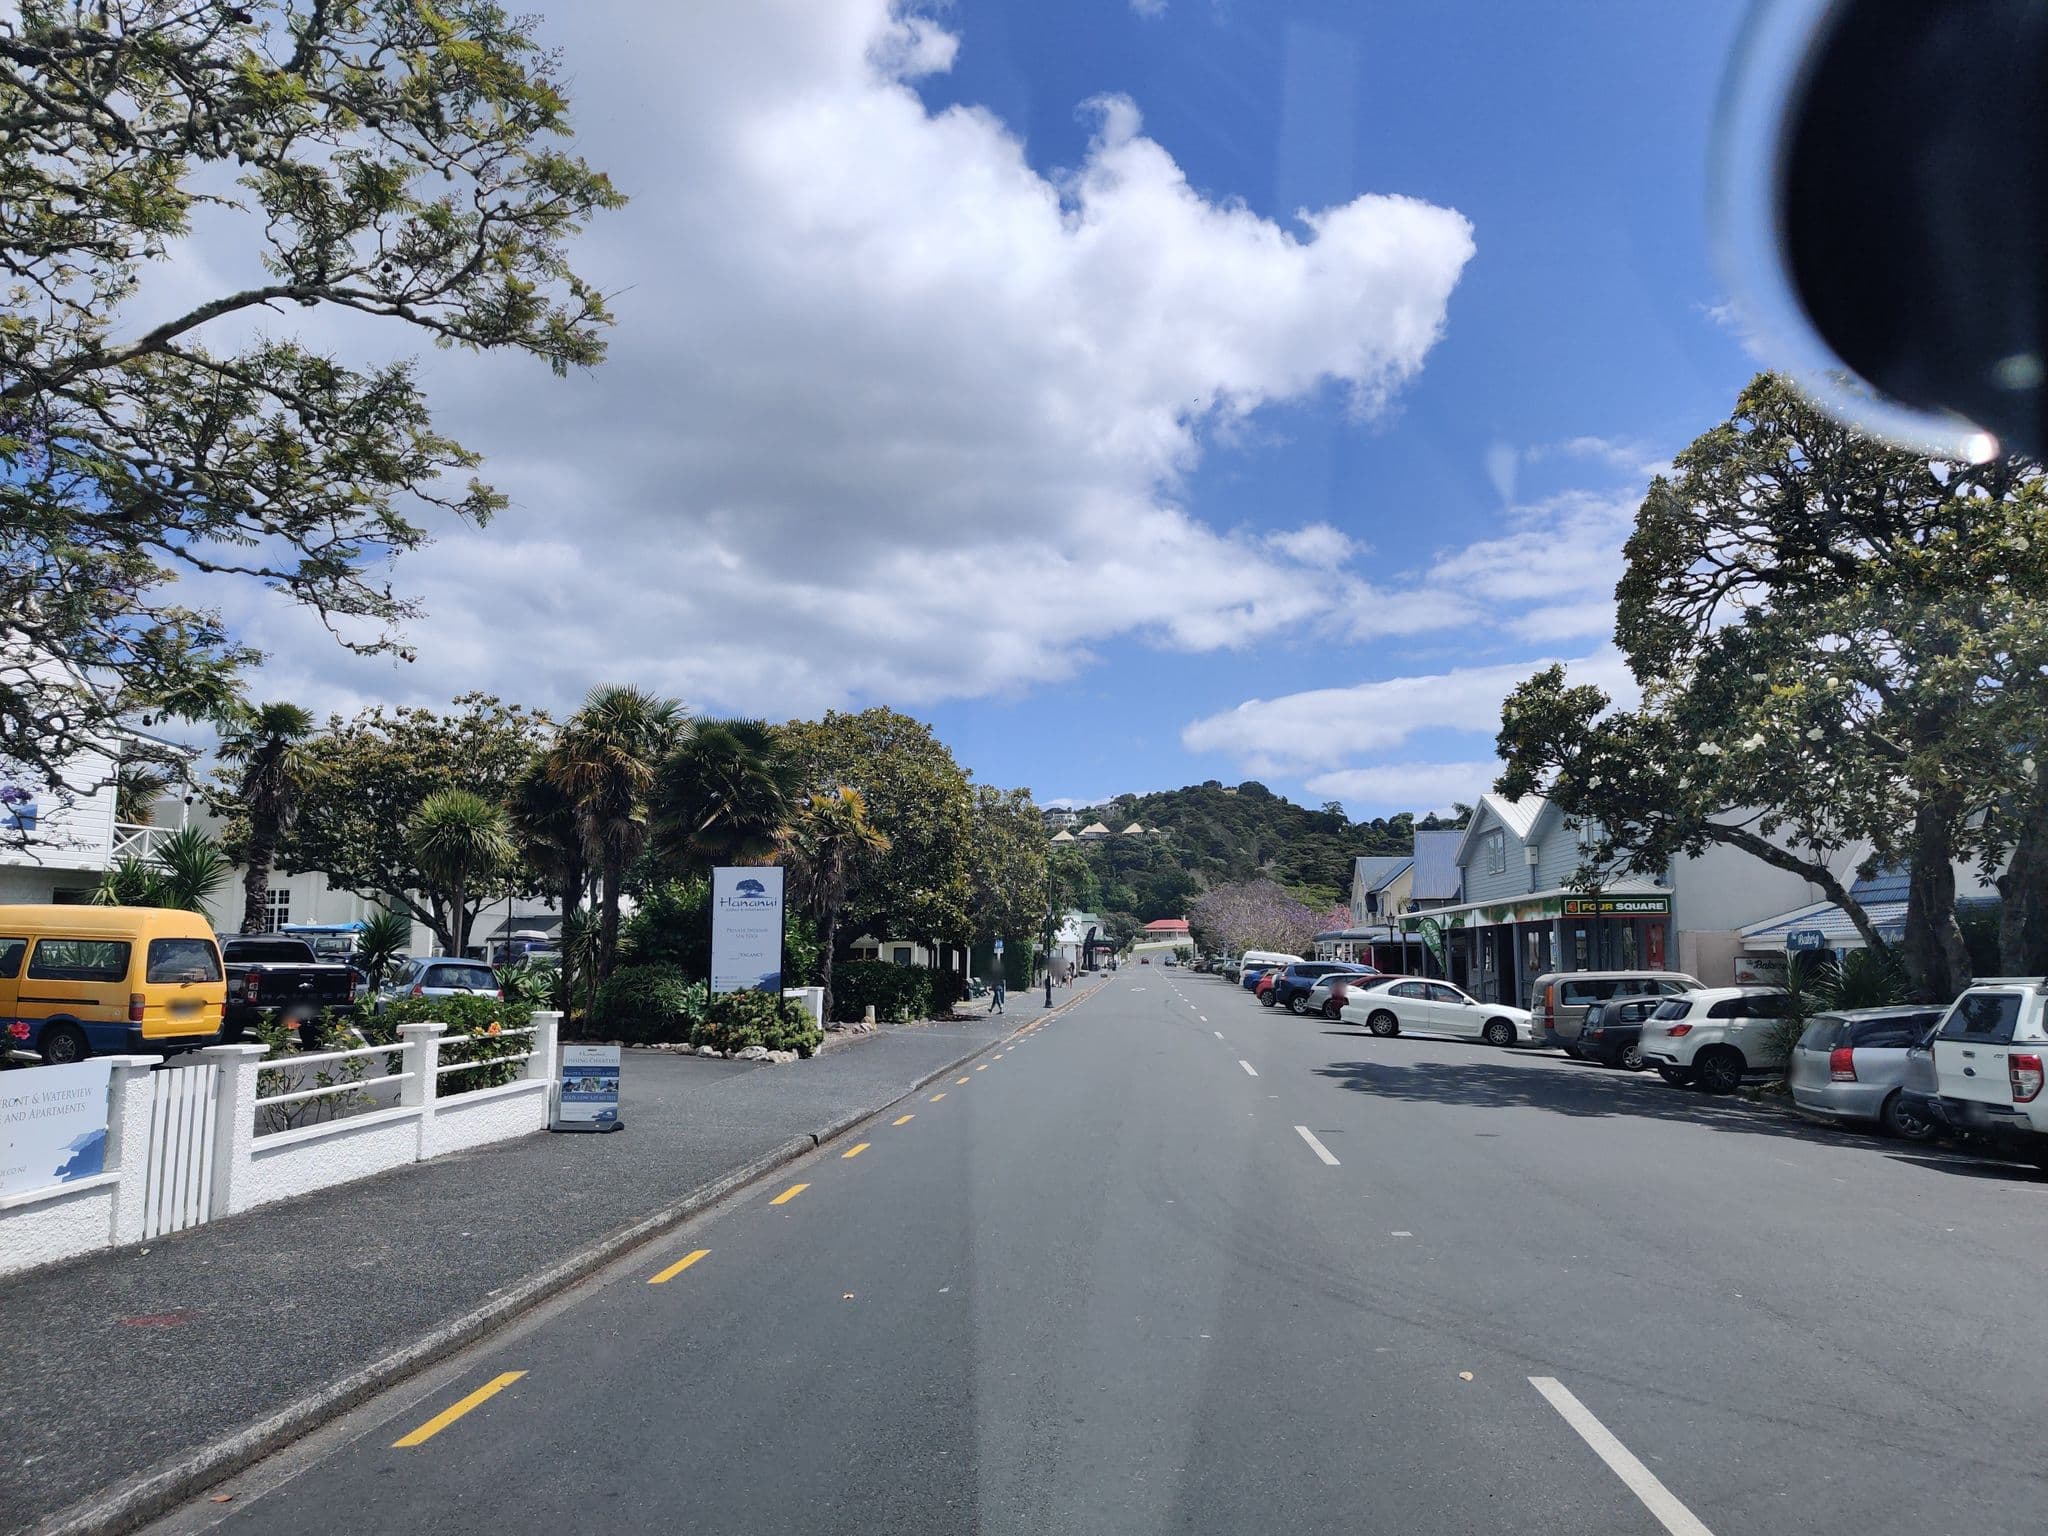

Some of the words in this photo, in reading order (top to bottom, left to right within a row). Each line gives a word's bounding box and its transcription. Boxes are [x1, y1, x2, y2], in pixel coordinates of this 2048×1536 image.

[719, 897, 777, 907] Hananui
[1616, 902, 1664, 911] SQUARE
[32, 1092, 40, 1104] &
[42, 1088, 93, 1103] WATERVIEW
[4, 1111, 26, 1123] AND
[29, 1103, 86, 1120] APARTMENTS
